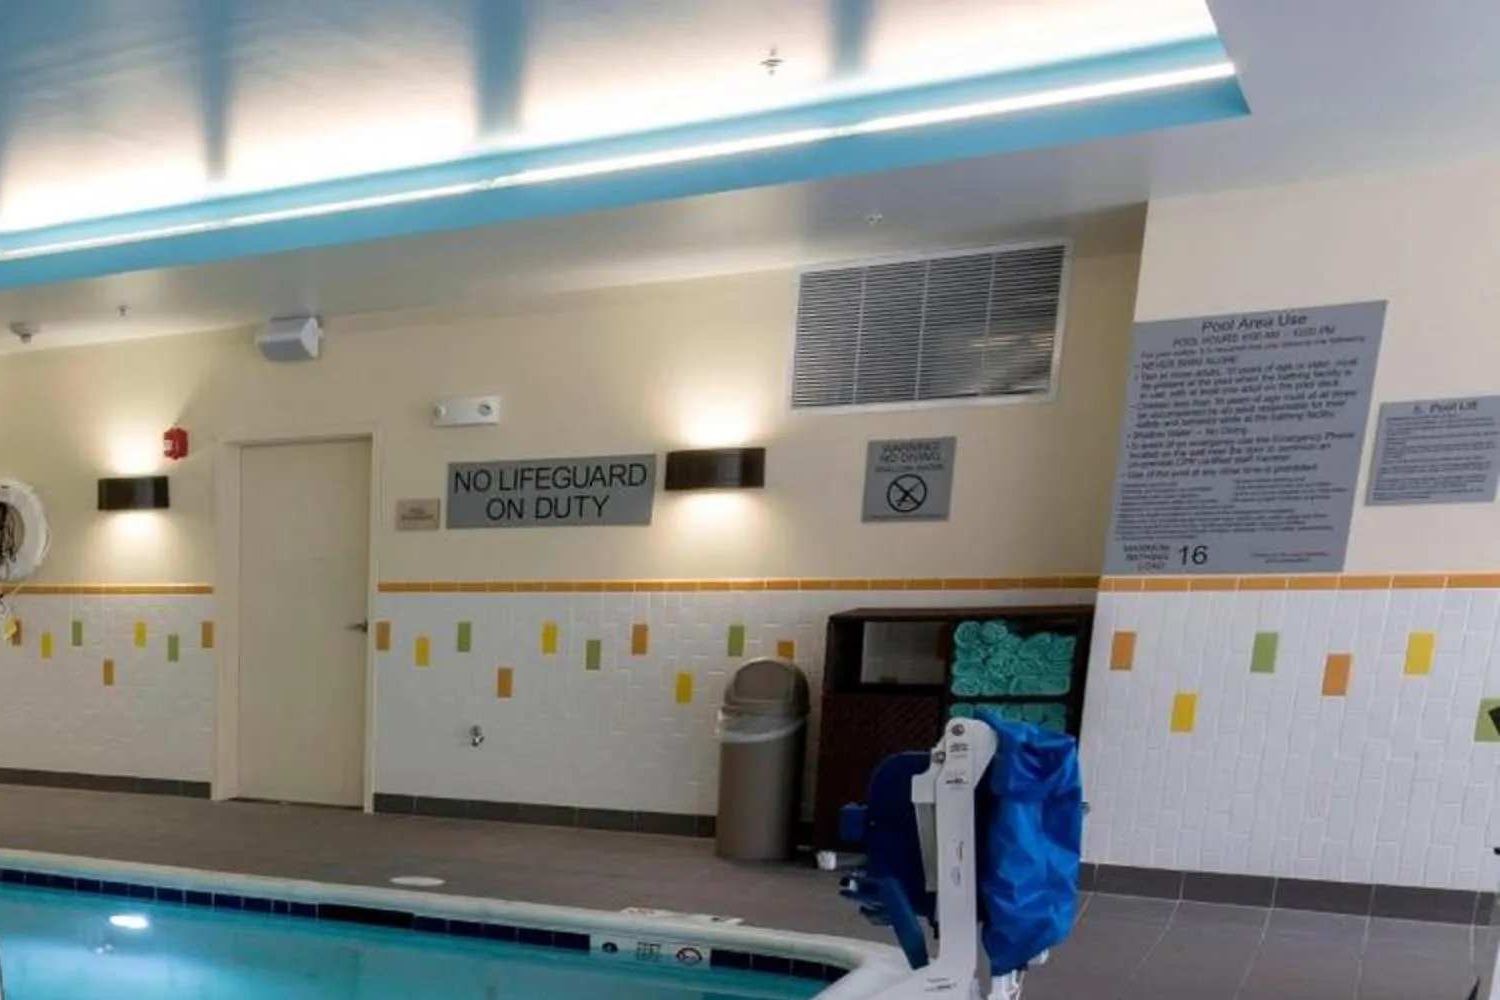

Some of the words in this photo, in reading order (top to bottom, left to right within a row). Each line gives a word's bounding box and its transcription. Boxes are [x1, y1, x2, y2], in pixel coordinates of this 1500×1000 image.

[1202, 321, 1235, 333] Pool
[1239, 318, 1274, 329] Area
[1278, 314, 1307, 327] Use
[454, 469, 492, 493] NO
[499, 463, 647, 491] LIFEGUARD
[486, 498, 524, 520] ON
[535, 495, 609, 519] DUTY
[1180, 546, 1208, 565] 16
